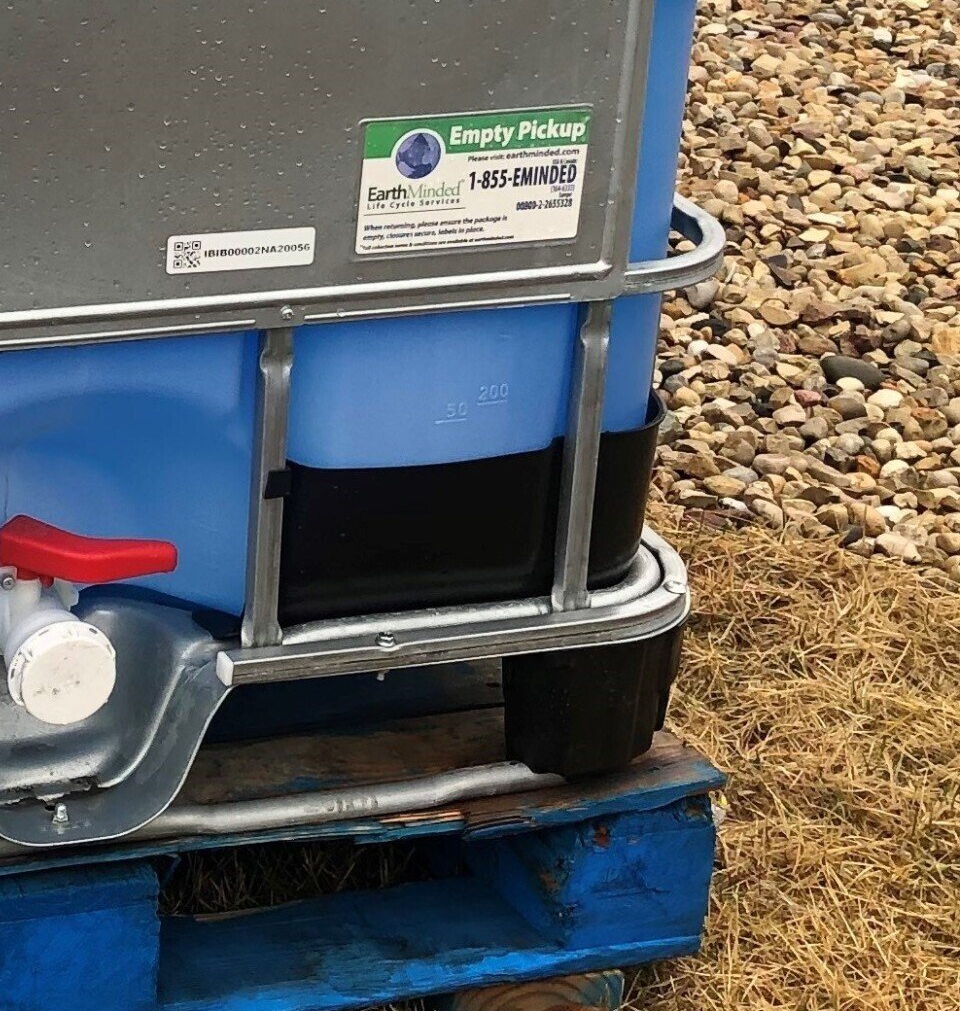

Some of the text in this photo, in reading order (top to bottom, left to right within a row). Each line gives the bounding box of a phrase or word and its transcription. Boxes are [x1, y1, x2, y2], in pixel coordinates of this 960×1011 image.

[449, 118, 586, 148] Empty Pickup
[506, 148, 580, 160] earthminded.com
[469, 164, 577, 190] 1-855-EMINDED
[389, 201, 416, 209] Cycle
[420, 198, 461, 207] Services
[478, 383, 509, 400] 200
